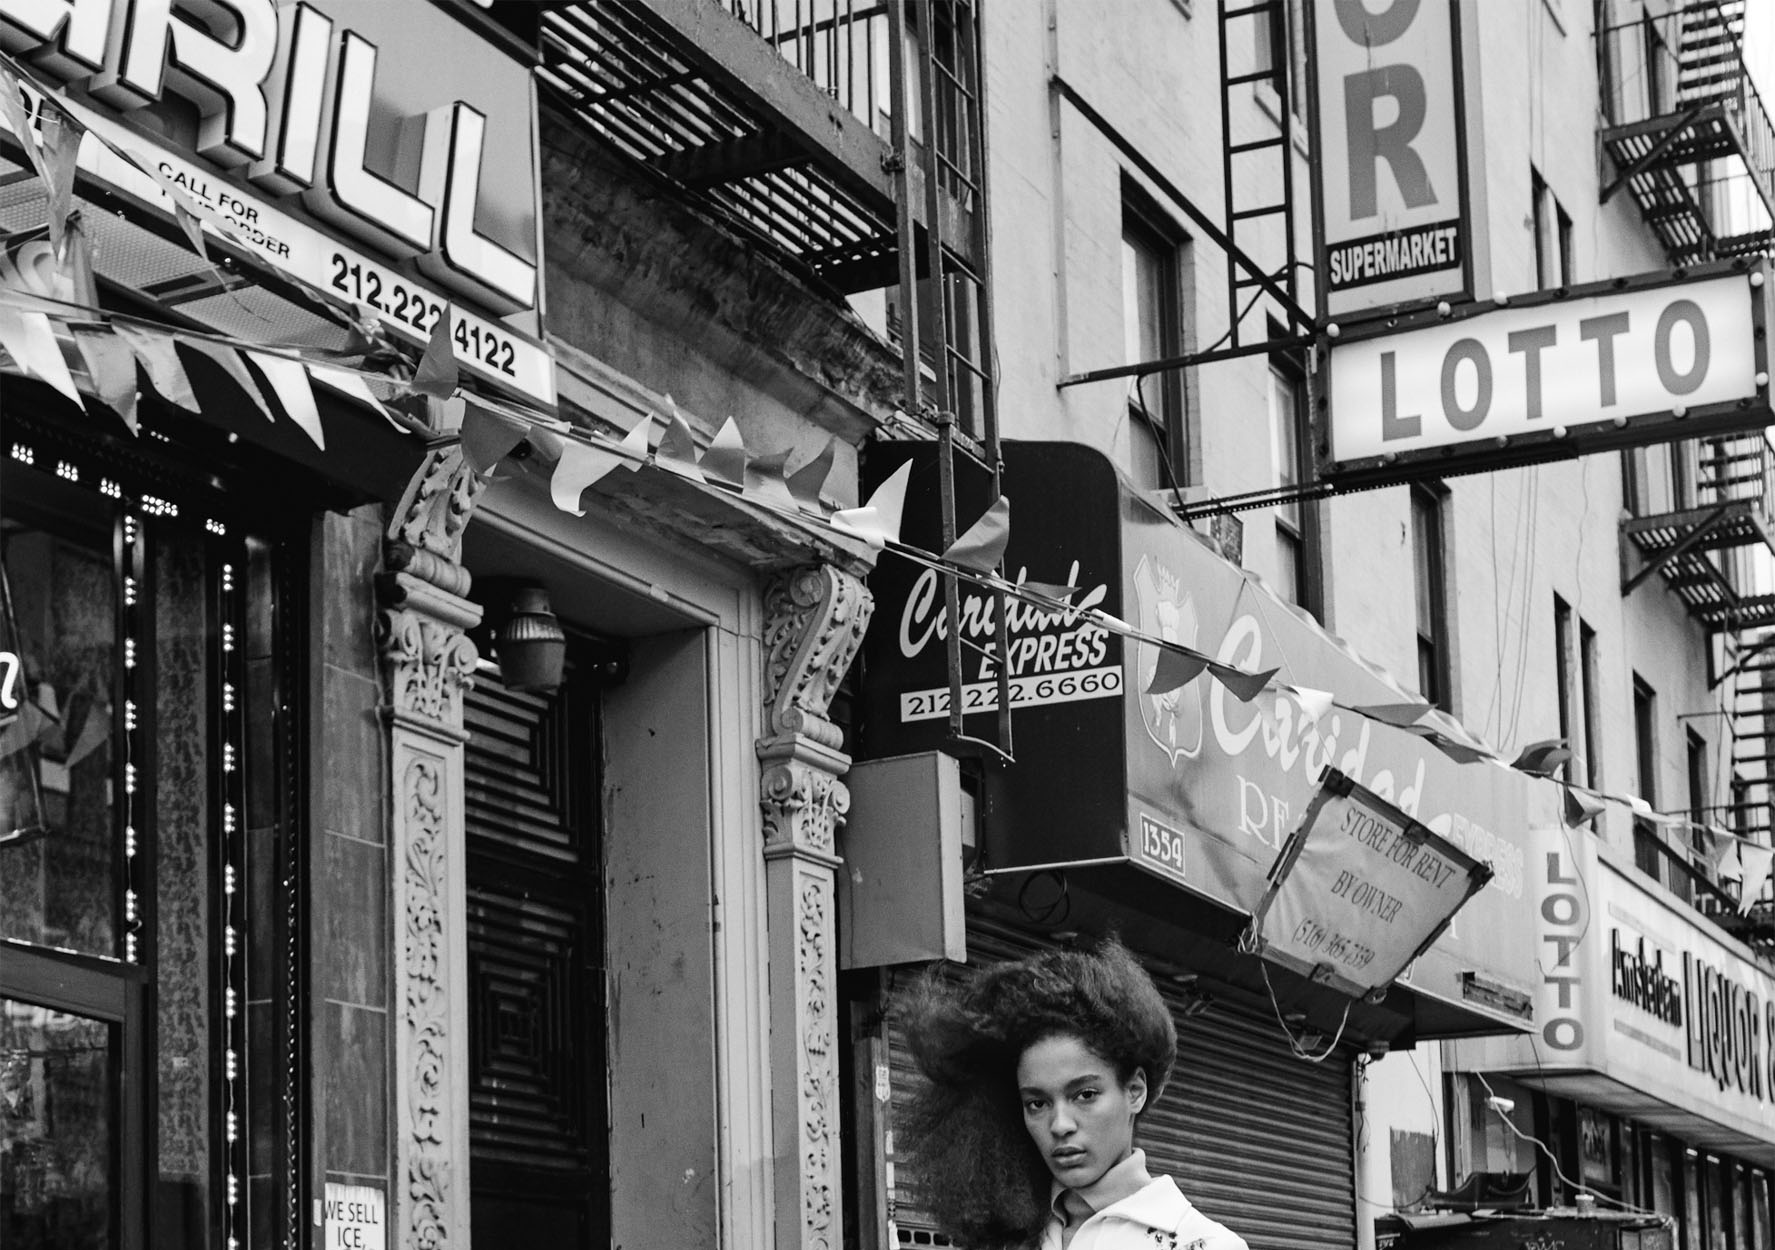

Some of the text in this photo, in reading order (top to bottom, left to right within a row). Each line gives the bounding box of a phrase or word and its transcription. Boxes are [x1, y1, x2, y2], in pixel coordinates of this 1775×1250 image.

[159, 162, 212, 201] CALL
[219, 193, 259, 224] FOR
[1330, 227, 1458, 285] SUPERMARKET
[332, 253, 516, 377] 212.2224122
[1380, 299, 1711, 442] LOTTO
[978, 628, 1109, 680] EXPRESS
[908, 672, 1120, 716] 212222.6660
[1340, 807, 1393, 853] STORE
[1385, 834, 1420, 870] FOR
[1411, 846, 1456, 889] RENT
[1331, 870, 1403, 924] BY OWNER
[1541, 852, 1584, 1051] LOTTO
[325, 1200, 378, 1225] WE SELL
